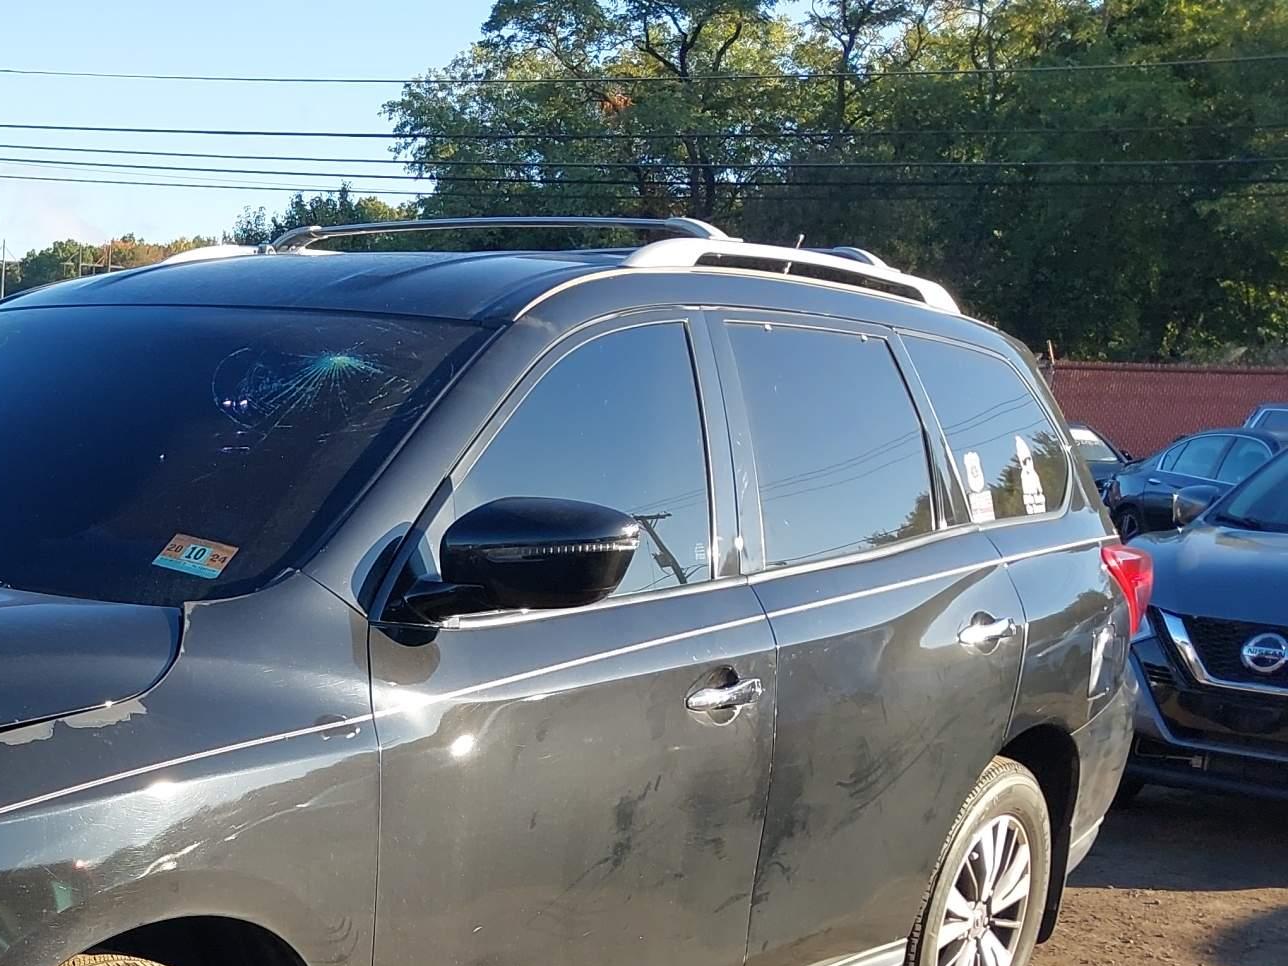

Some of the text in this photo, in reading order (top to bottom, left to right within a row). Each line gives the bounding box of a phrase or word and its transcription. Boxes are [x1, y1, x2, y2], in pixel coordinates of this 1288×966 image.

[167, 543, 184, 553] 20
[185, 546, 207, 560] 10
[210, 553, 228, 564] 24
[1247, 647, 1286, 657] NISSAN
